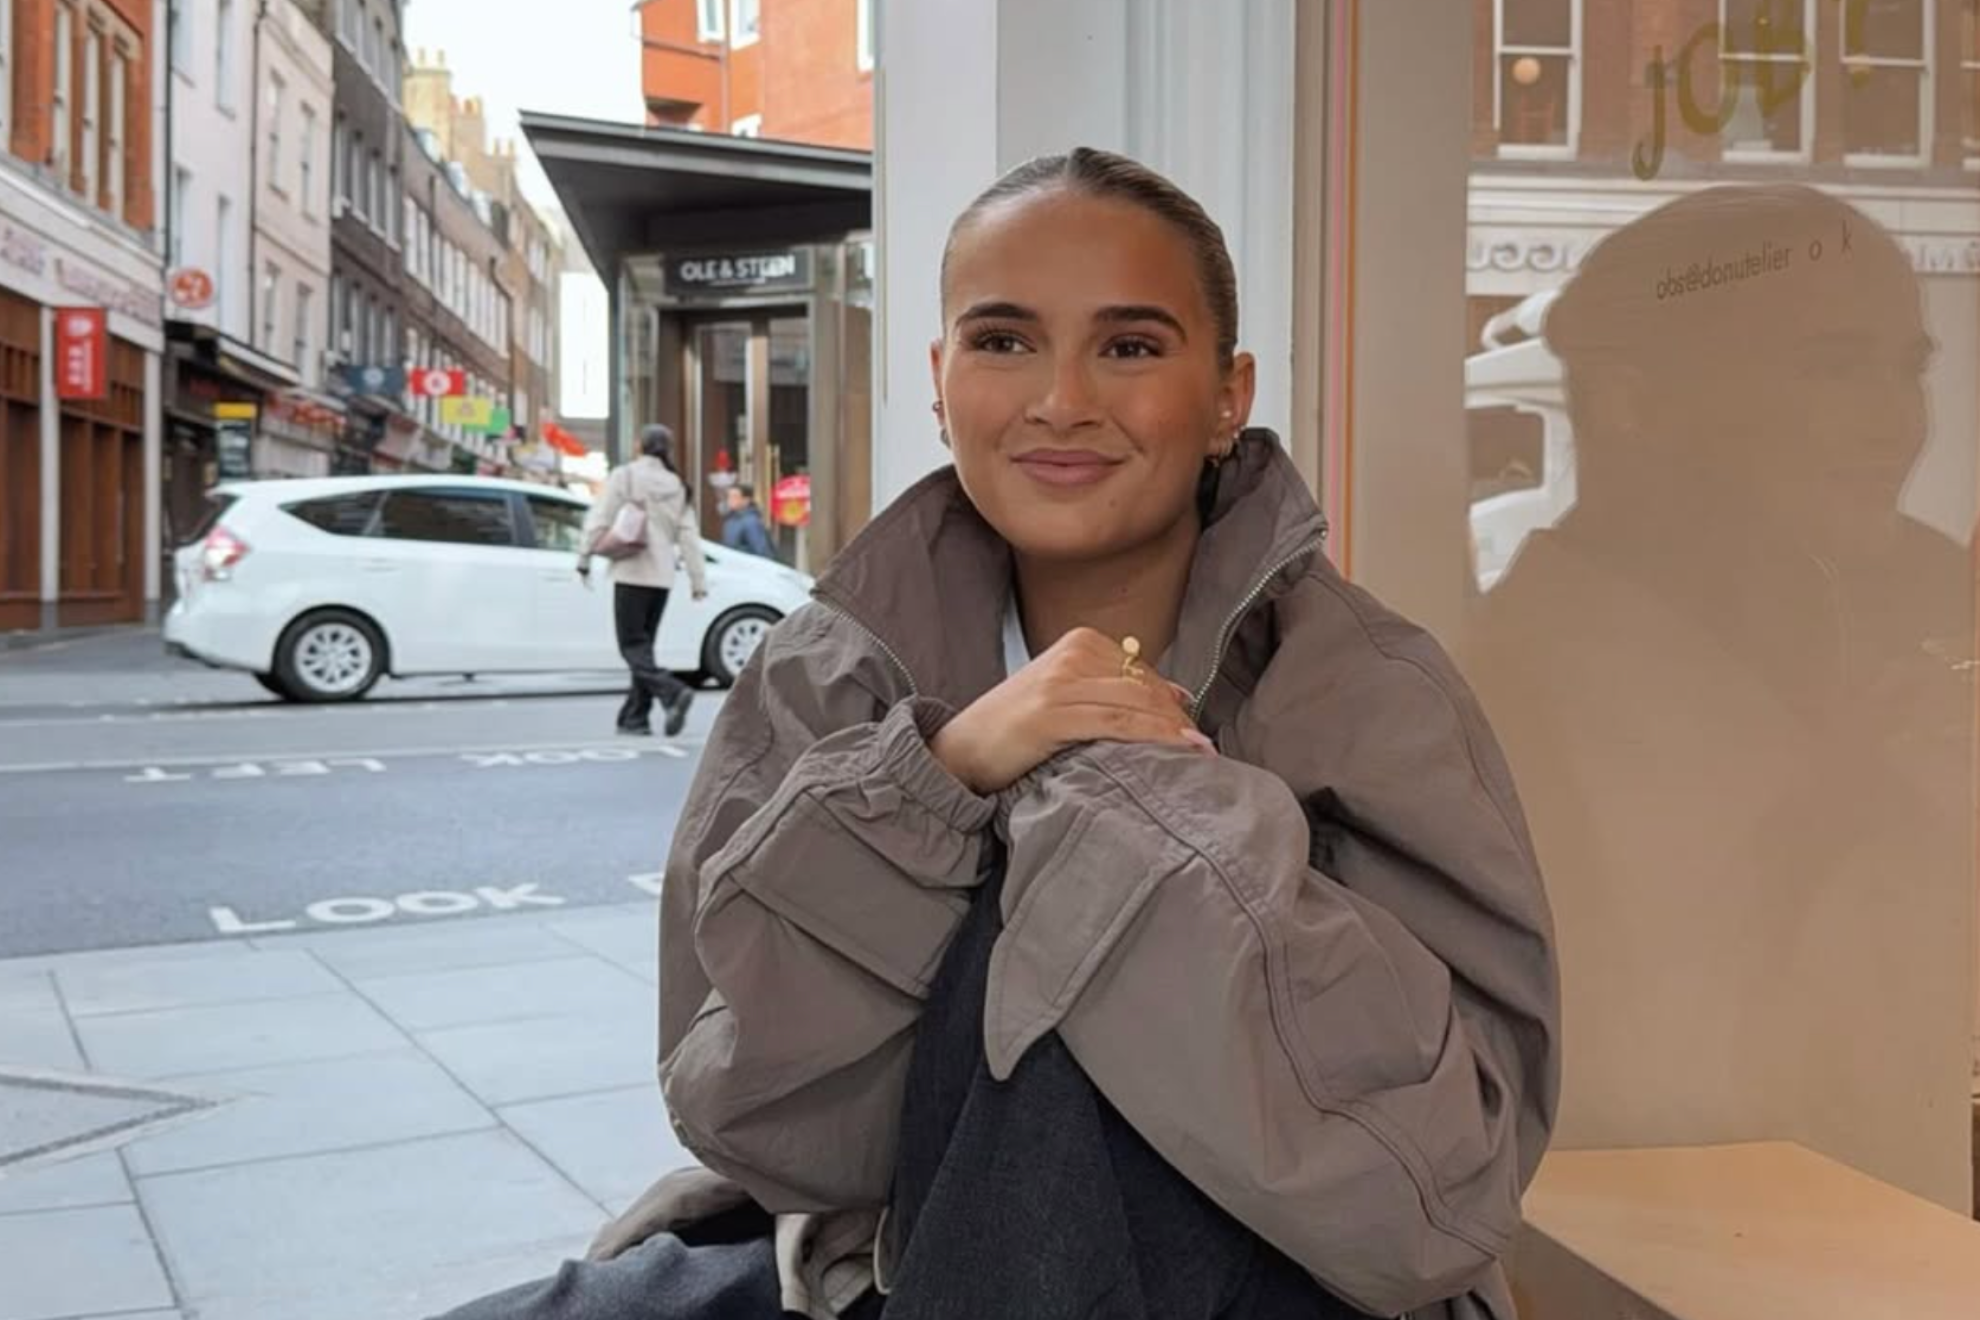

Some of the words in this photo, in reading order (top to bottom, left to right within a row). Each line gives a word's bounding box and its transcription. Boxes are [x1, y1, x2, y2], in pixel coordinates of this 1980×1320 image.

[680, 260, 716, 282] OLE
[719, 258, 733, 278] &
[460, 744, 690, 768] LOOK
[124, 756, 388, 783] LEFT
[208, 882, 567, 934] LOOK
